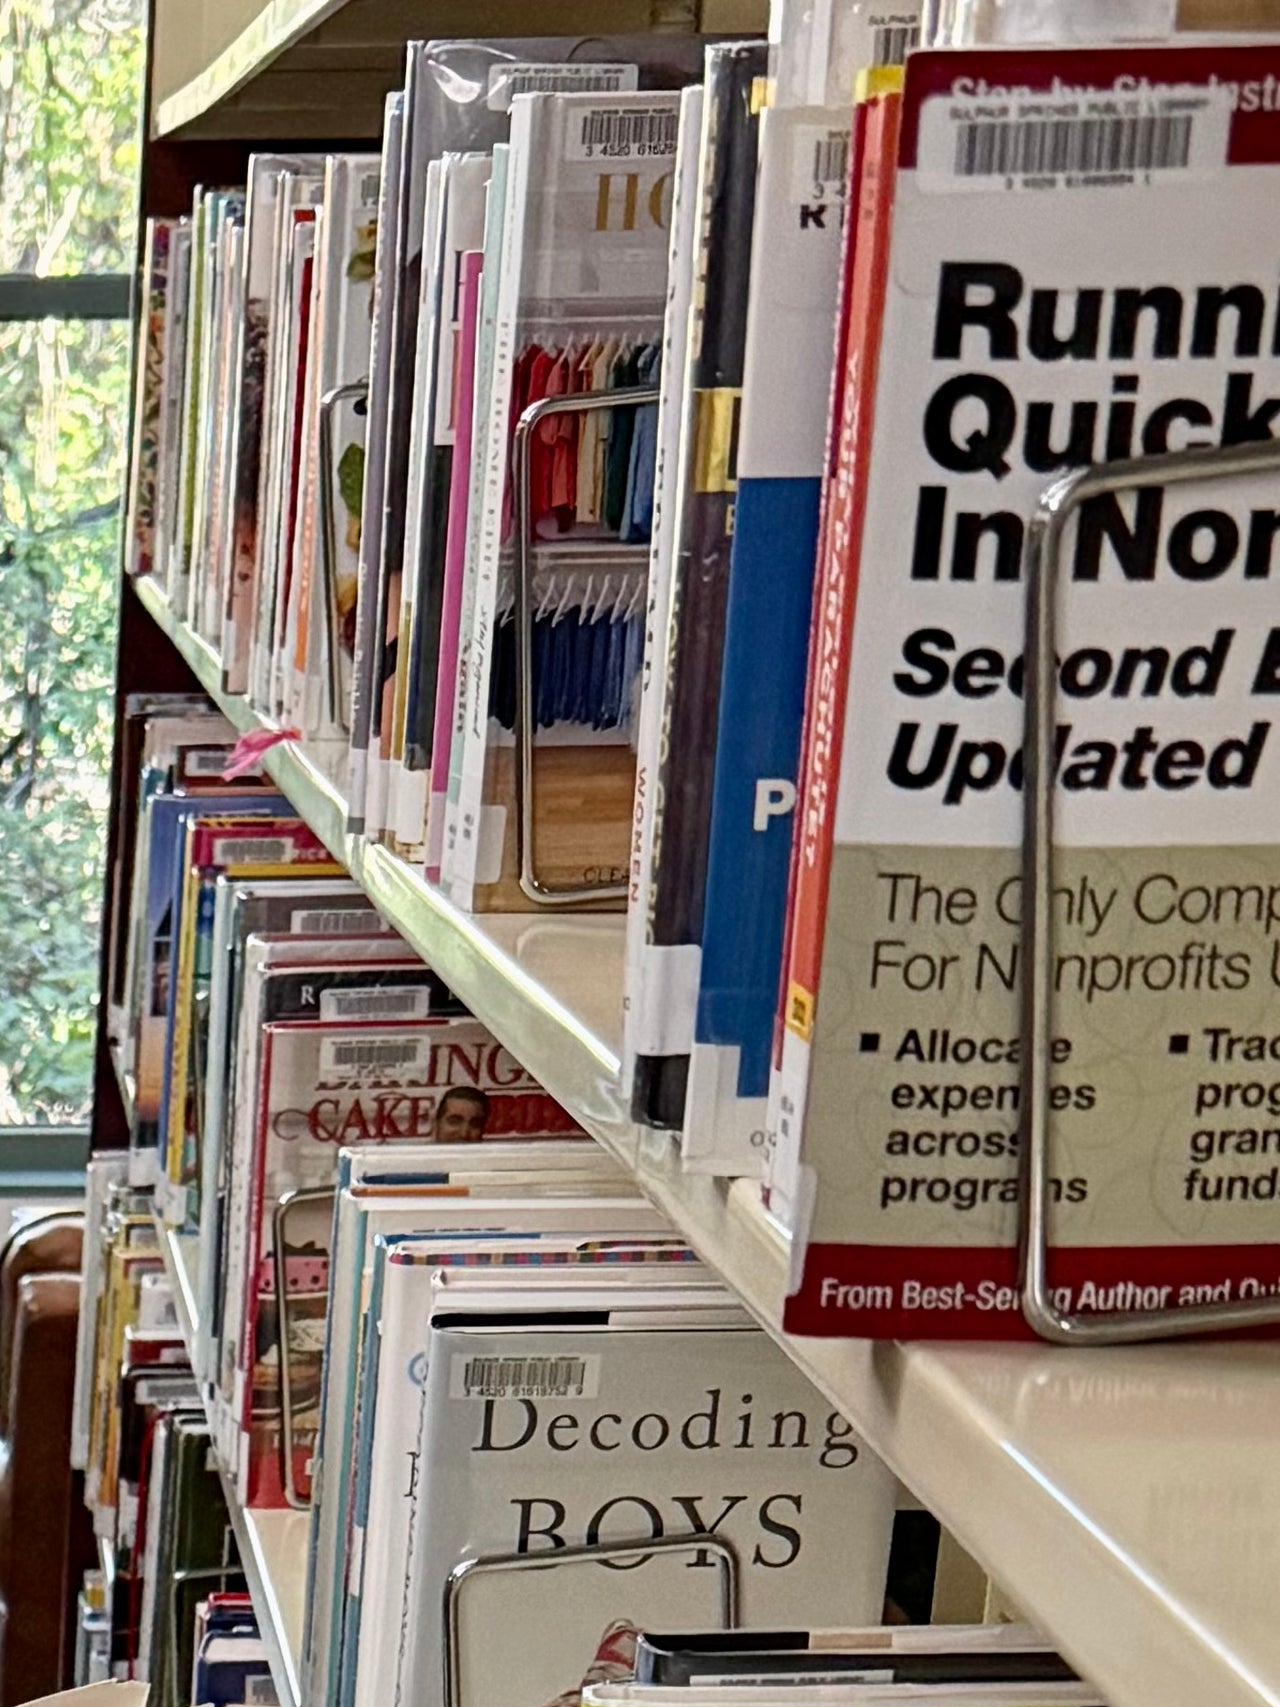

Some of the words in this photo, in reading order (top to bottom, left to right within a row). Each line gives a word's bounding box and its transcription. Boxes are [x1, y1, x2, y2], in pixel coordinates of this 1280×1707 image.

[932, 260, 1280, 362] Runn
[910, 484, 1025, 582] In
[891, 627, 1232, 698] Seond
[885, 722, 1272, 805] Upated
[630, 766, 648, 904] WOMEN
[876, 872, 978, 924] The
[869, 941, 958, 993] For
[974, 938, 1252, 1003] Nnprofits
[893, 1028, 1073, 1064] Allocae
[274, 1094, 437, 1144] CAKE
[889, 1077, 1097, 1116] expenes
[819, 1277, 895, 1310] From
[1075, 1278, 1171, 1311] Author
[470, 1388, 862, 1470] Decoding
[512, 1491, 805, 1572] BOYS
